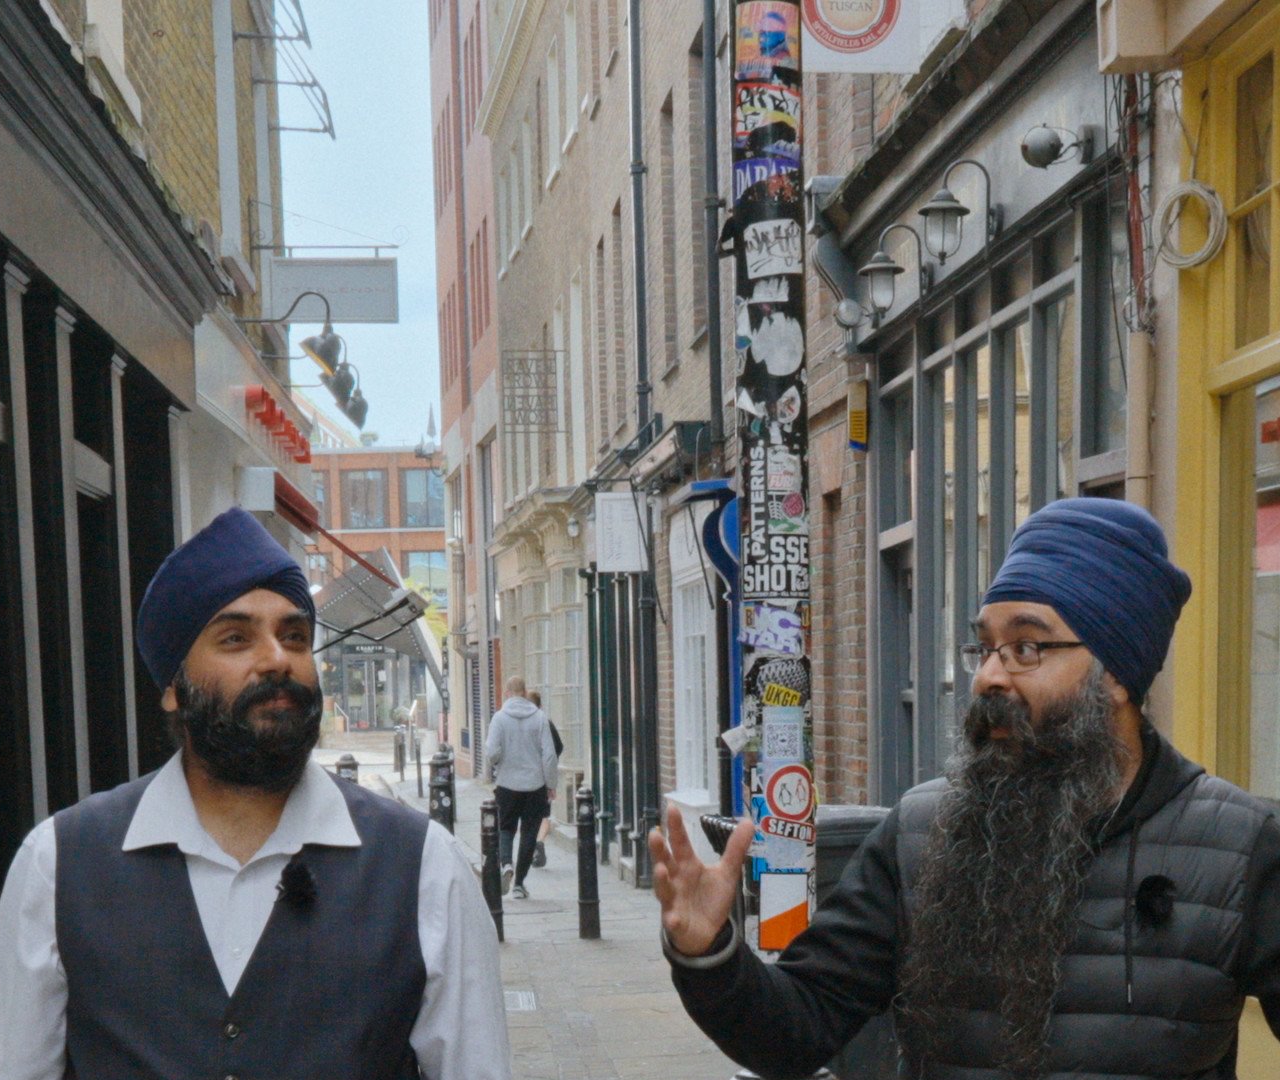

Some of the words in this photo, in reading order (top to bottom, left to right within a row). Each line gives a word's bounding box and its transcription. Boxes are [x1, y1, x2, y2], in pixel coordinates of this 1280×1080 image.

[829, 1, 873, 12] TUSCAN
[743, 536, 809, 564] PSSE
[743, 564, 809, 592] SHOT
[768, 818, 812, 841] SEFTON
